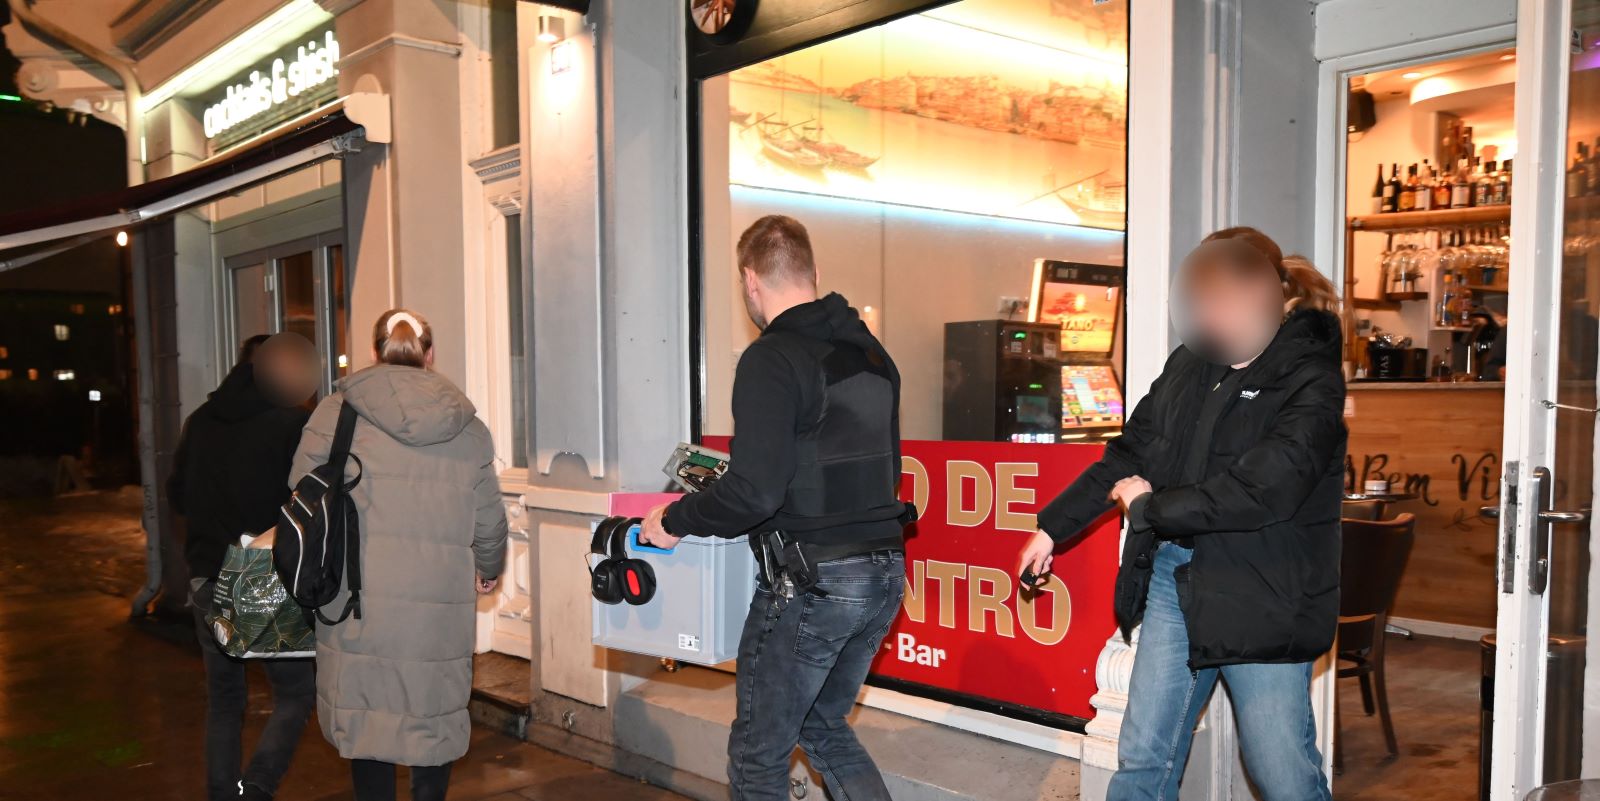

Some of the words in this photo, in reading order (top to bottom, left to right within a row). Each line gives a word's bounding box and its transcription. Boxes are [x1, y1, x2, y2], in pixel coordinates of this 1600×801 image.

[203, 70, 272, 138] cocktails
[271, 58, 288, 104] &
[946, 459, 1039, 532] DE
[897, 632, 947, 668] Bar
